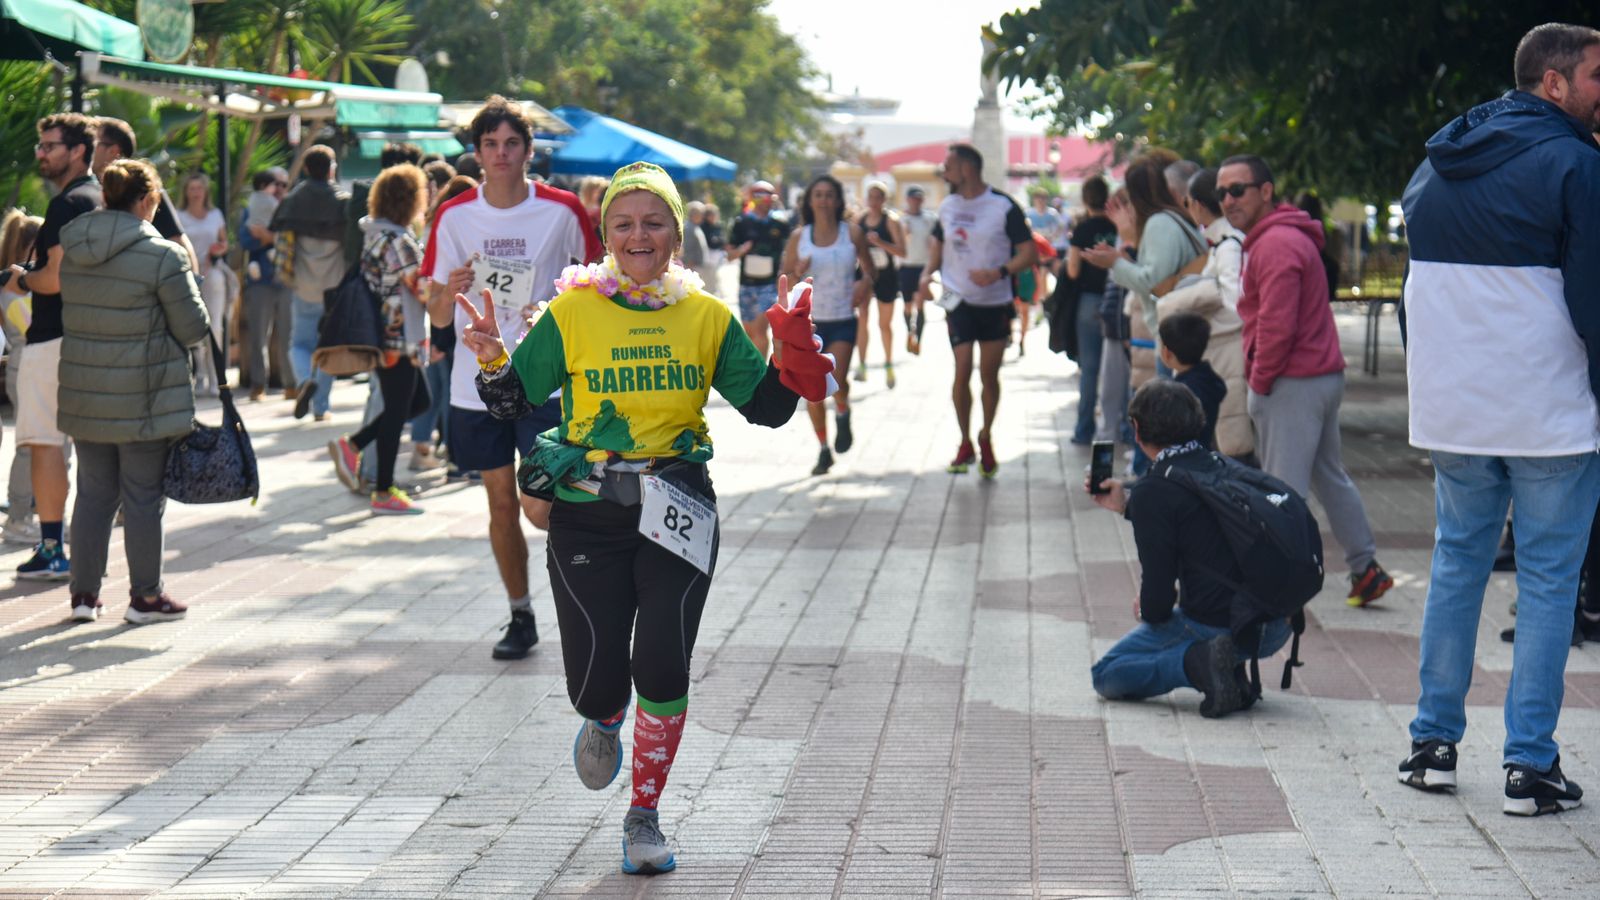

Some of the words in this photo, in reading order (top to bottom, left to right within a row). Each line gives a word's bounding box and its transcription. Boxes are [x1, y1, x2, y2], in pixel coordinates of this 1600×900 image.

[486, 271, 514, 293] 42
[611, 345, 672, 360] RUNNERS
[585, 359, 705, 393] BARREÑOS
[667, 485, 680, 498] SAN
[681, 494, 711, 519] SILVESTRE
[664, 505, 693, 541] 82
